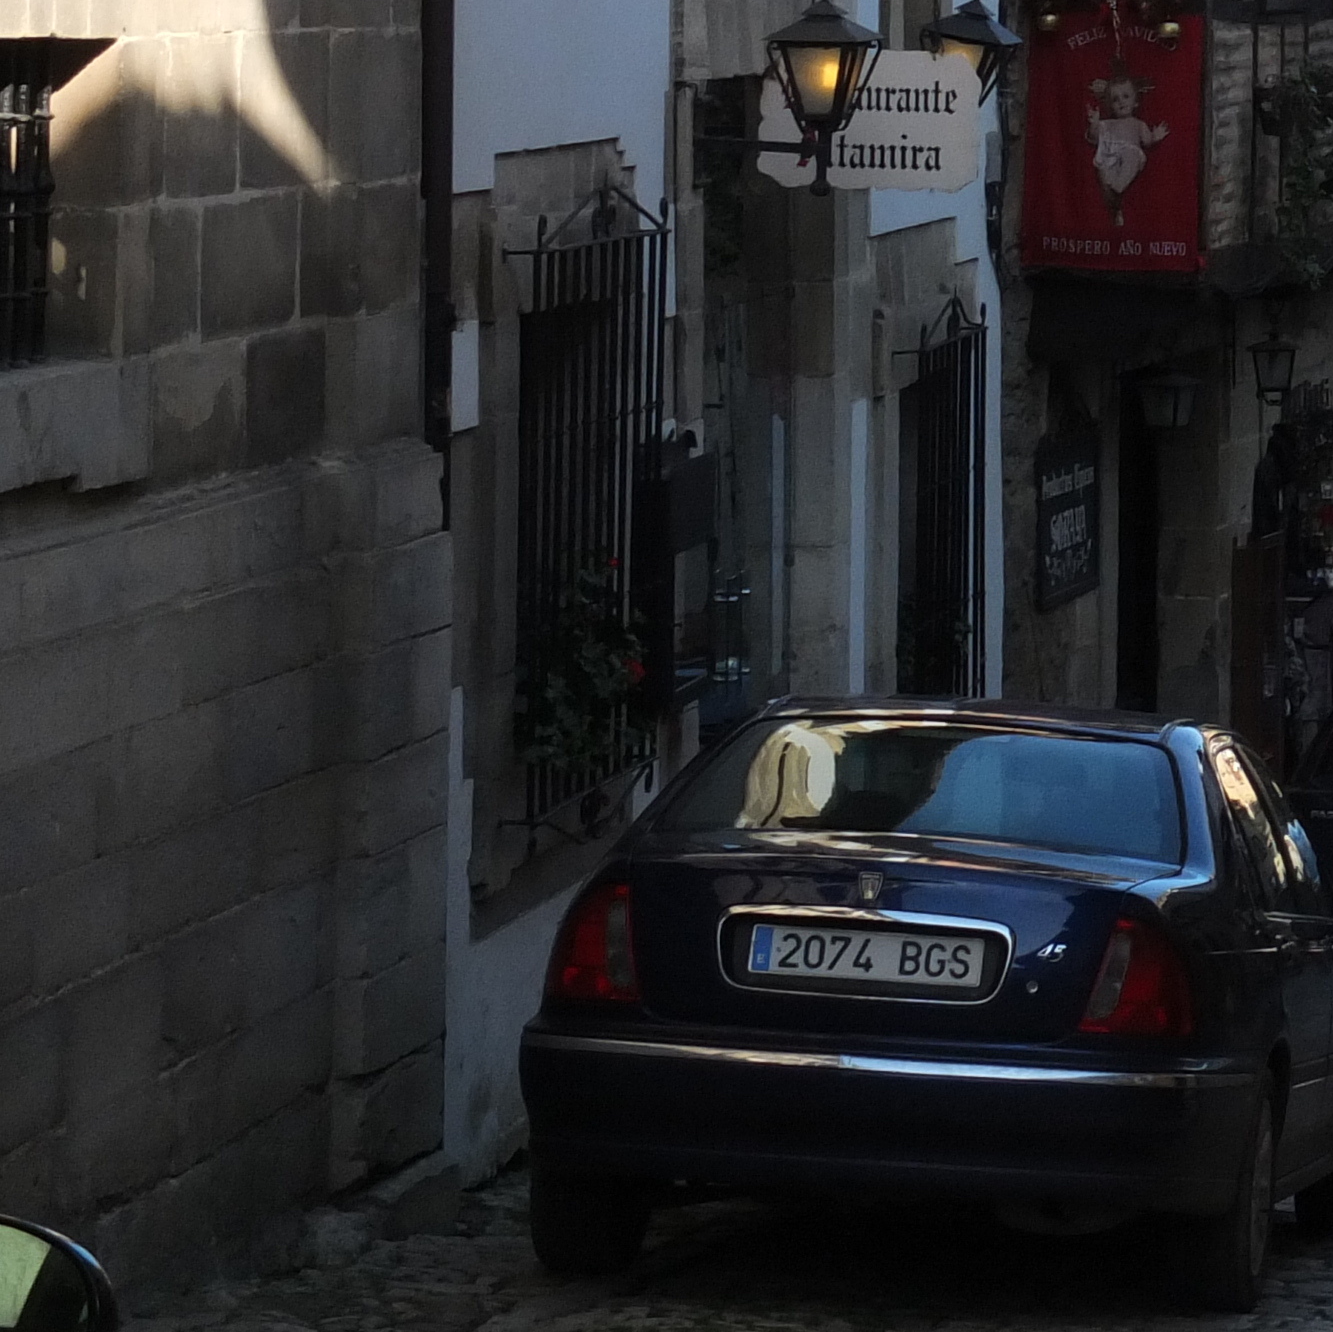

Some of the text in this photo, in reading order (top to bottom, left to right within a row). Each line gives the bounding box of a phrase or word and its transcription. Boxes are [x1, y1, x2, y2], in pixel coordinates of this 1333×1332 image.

[1067, 26, 1107, 50] FELIZ
[1042, 236, 1187, 256] PROSPERO AÑO NUEVO
[778, 933, 971, 979] 2074 BGS
[1037, 943, 1068, 962] 45
